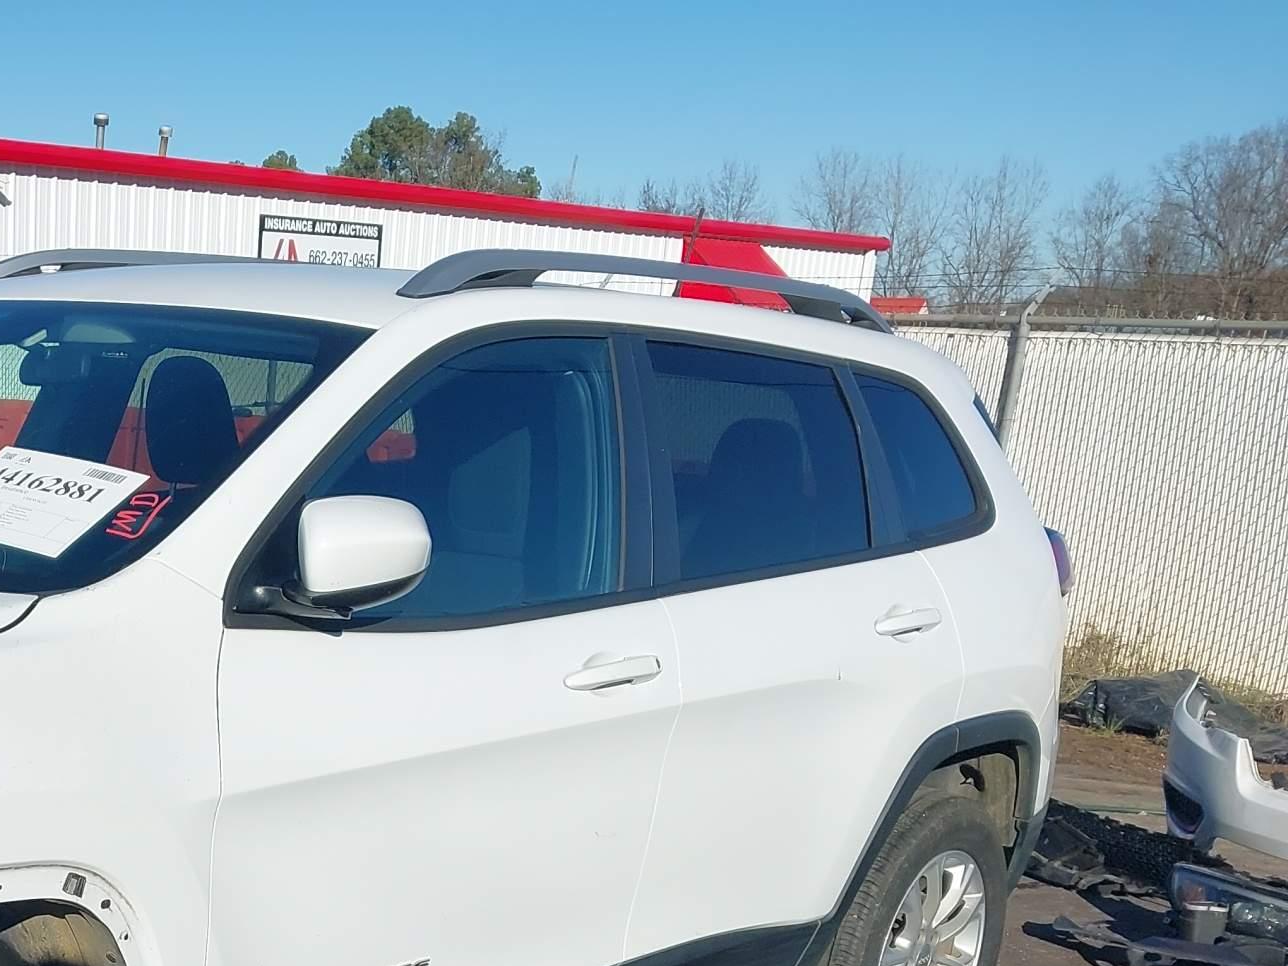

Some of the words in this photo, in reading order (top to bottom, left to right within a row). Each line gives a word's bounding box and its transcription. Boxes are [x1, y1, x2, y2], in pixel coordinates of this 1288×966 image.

[264, 216, 313, 232] INSURANCE
[314, 221, 338, 234] AUTO
[338, 224, 379, 238] AUCTIONS
[308, 250, 375, 267] 662-237-0455
